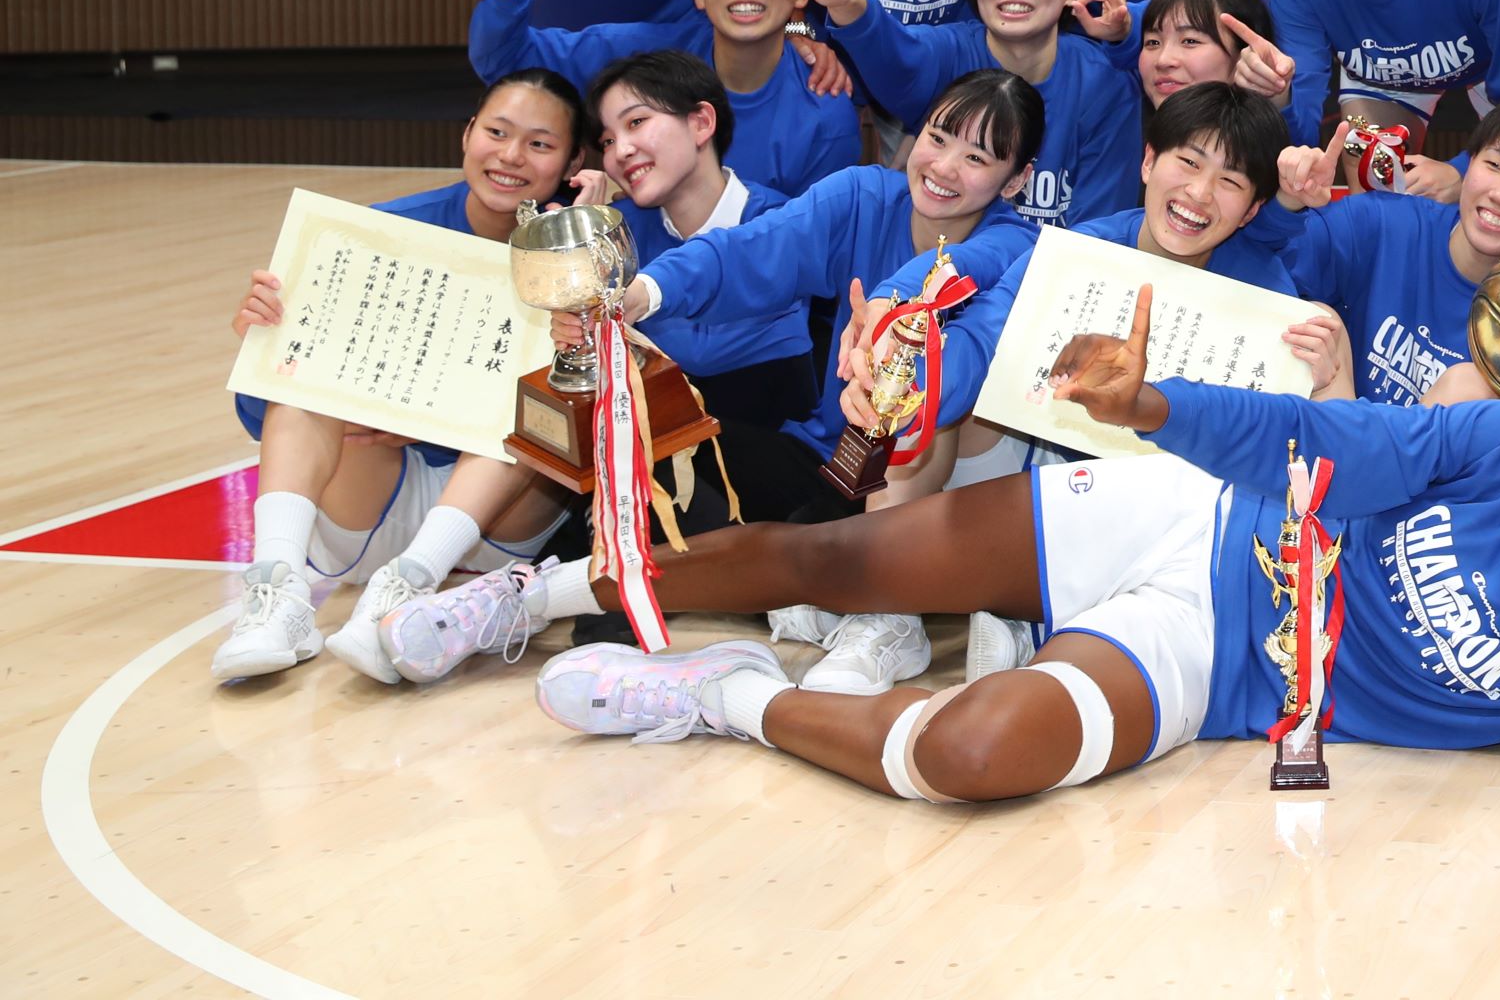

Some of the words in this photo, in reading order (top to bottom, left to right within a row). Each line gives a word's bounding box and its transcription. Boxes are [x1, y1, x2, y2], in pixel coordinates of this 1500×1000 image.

[463, 294, 493, 366] リバウンド王
[484, 318, 513, 373] 表彰状
[618, 495, 638, 566] 早稲田大学
